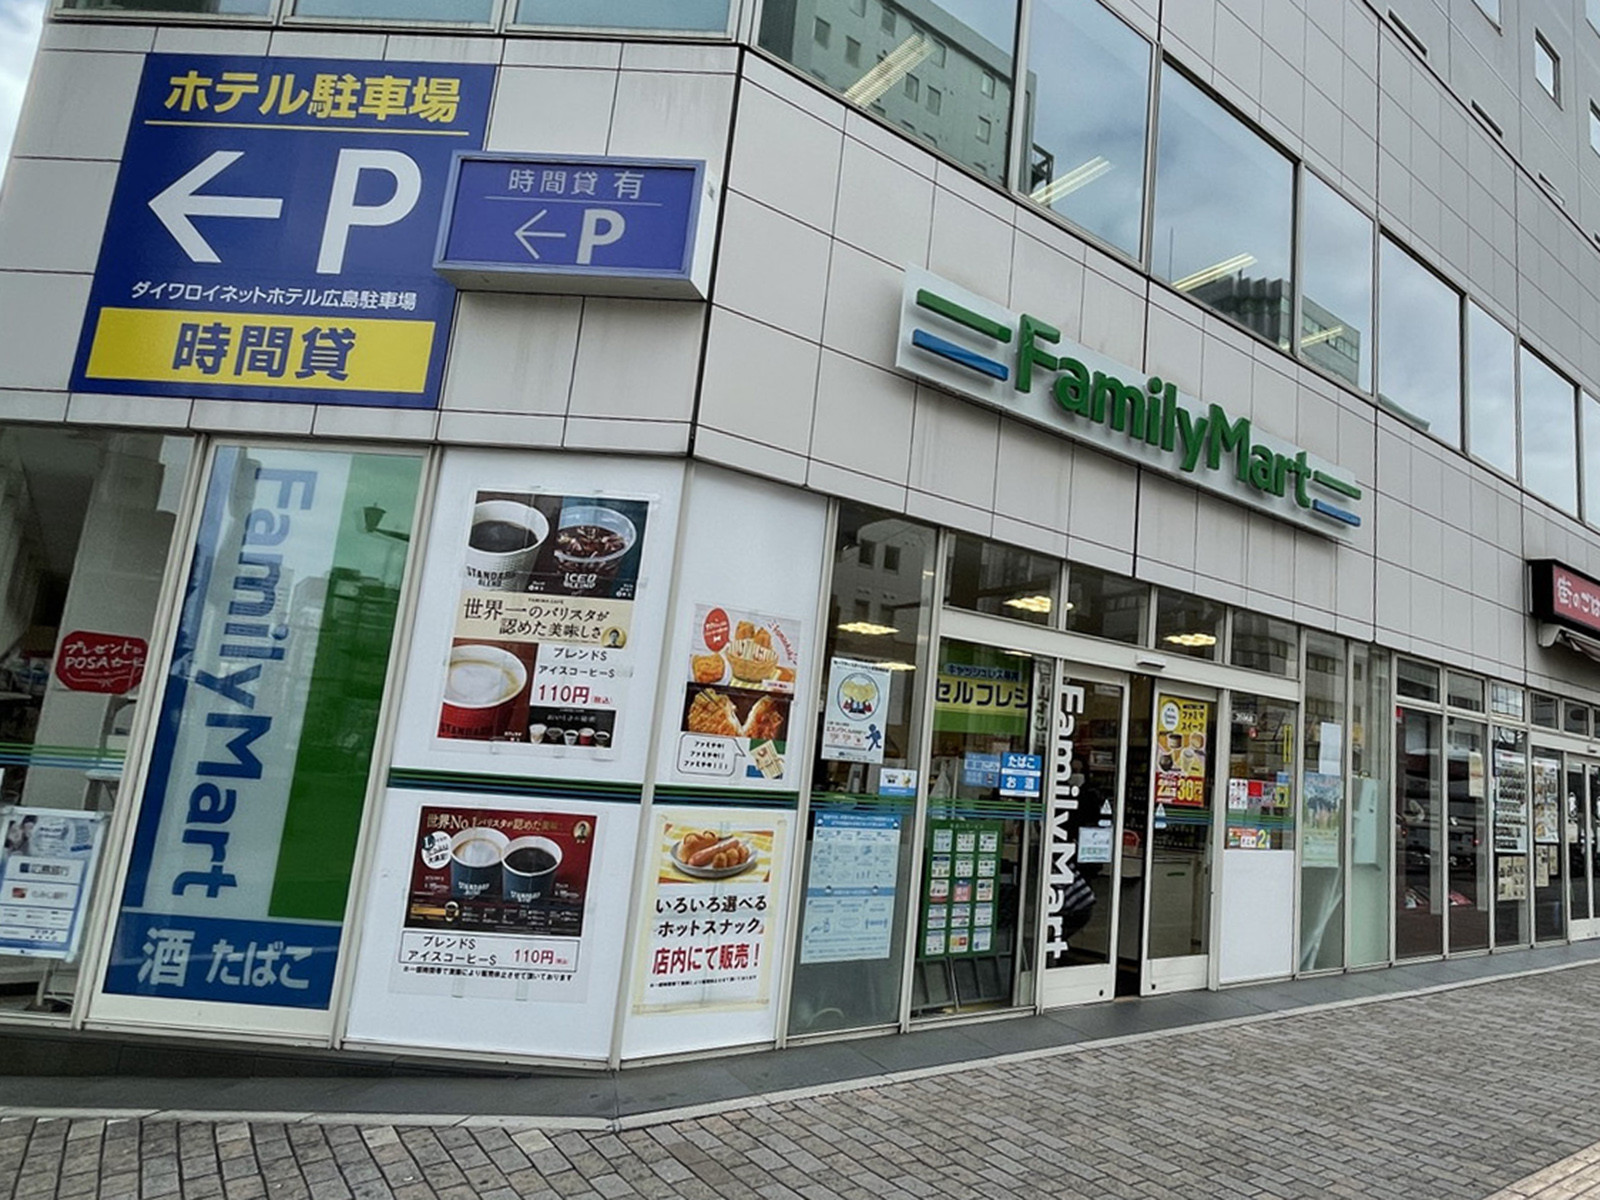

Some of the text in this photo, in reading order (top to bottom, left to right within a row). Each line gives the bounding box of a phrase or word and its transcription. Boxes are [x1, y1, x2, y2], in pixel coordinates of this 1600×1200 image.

[164, 69, 460, 125] ホテル駐車場
[508, 168, 645, 200] 時間貸 有
[316, 148, 422, 275] P
[576, 208, 627, 265] P
[131, 280, 418, 311] ダイワロイネットホテル広島駐車場
[172, 322, 357, 382] 時間貸
[1014, 313, 1313, 509] FamilyMart
[464, 598, 610, 623] 世界一のバリスタが
[499, 617, 602, 640] 認めた美味しさ
[553, 647, 608, 662] ブレンドS
[172, 467, 319, 900] FamilyMart
[539, 664, 616, 679] アイスコーヒーS
[539, 684, 590, 705] 110円
[655, 894, 768, 914] いろいろ選べる
[657, 917, 761, 938] ホットスナック
[422, 935, 477, 950] ブレンドS
[137, 926, 316, 991] 酒 たばこ
[407, 949, 498, 966] アイスコーヒーS
